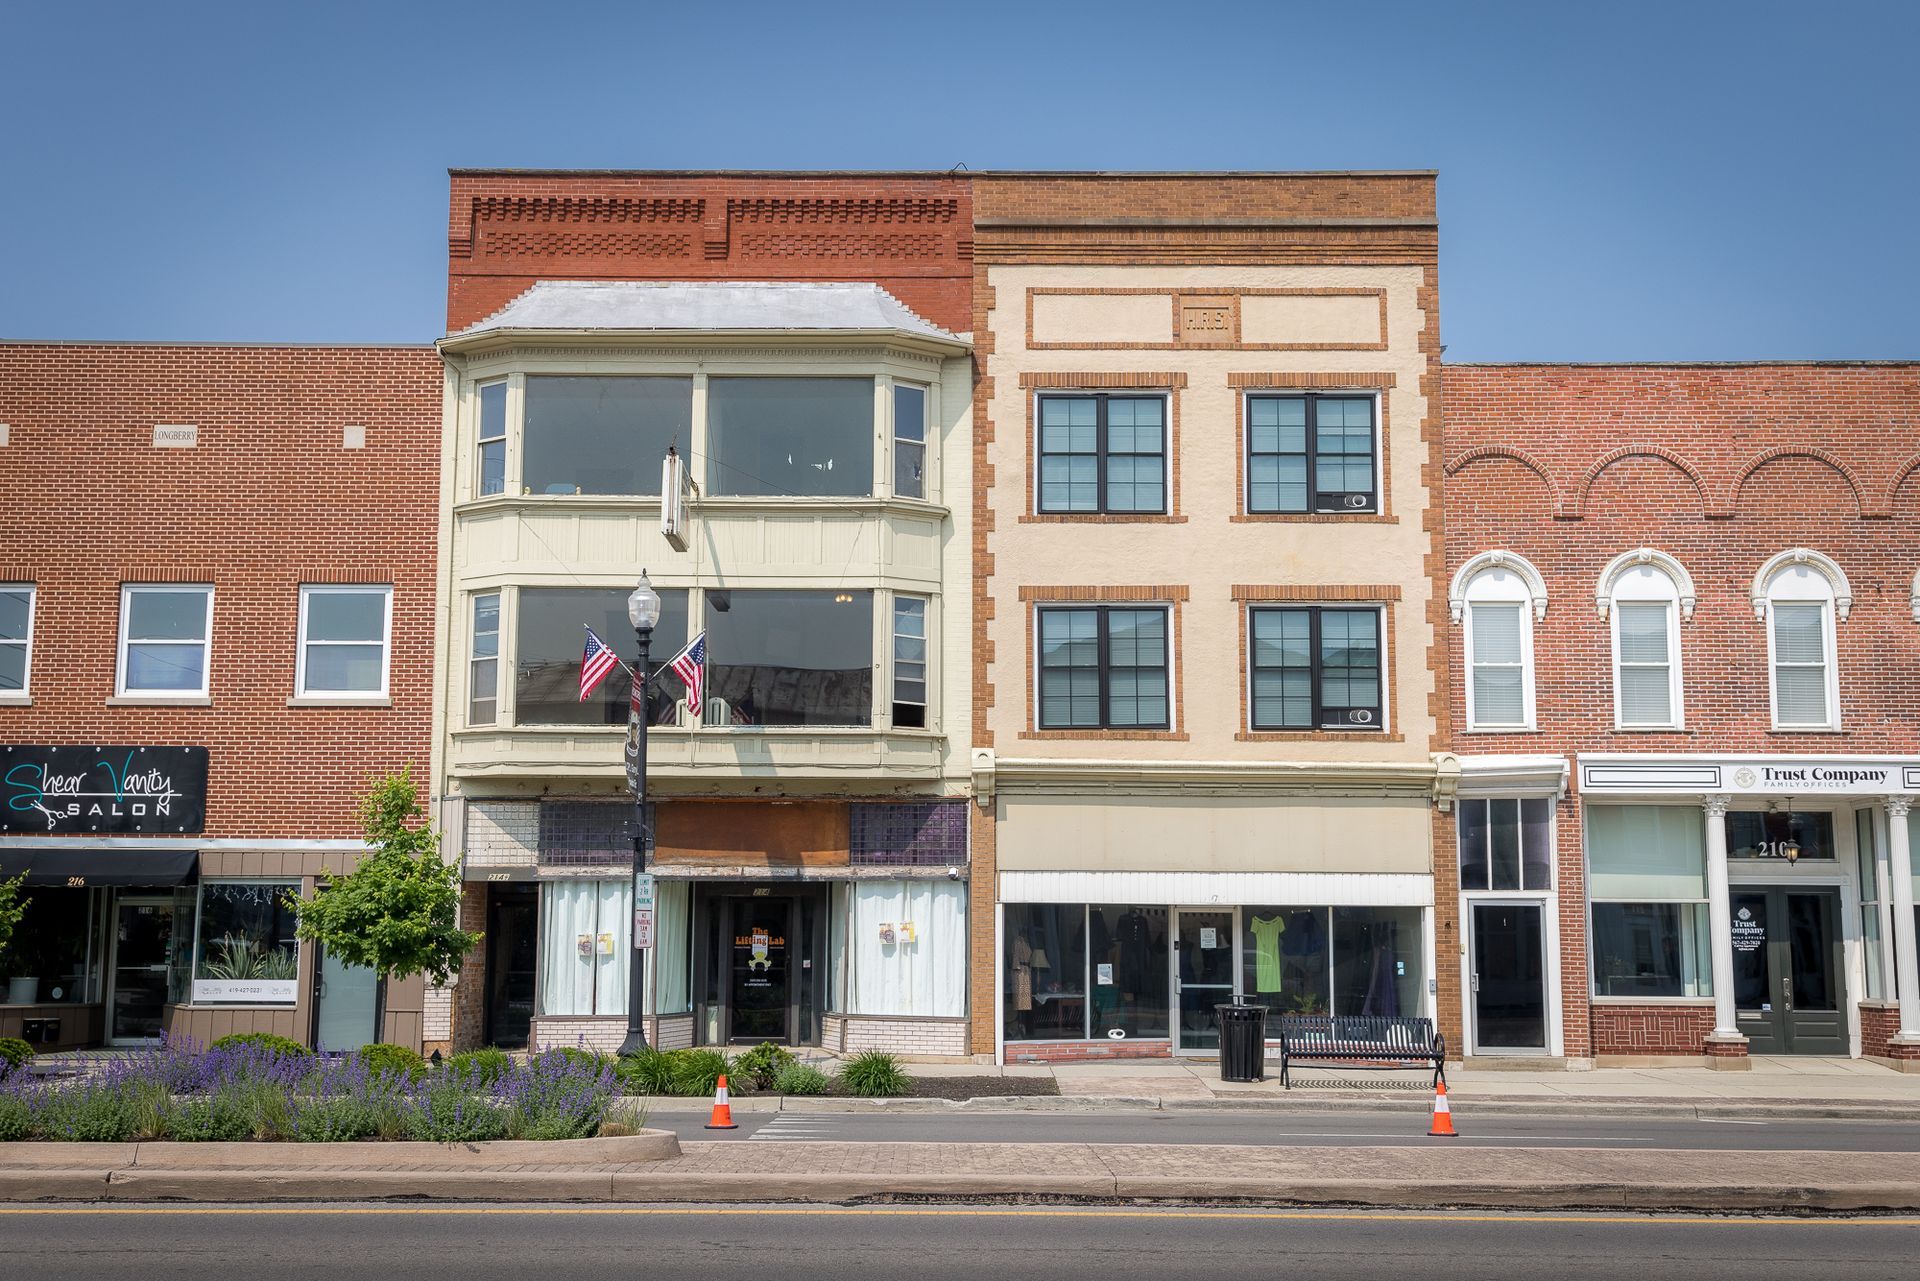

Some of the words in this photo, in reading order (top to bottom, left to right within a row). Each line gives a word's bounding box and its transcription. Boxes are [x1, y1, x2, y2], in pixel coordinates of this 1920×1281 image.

[154, 430, 197, 441] LONGBERRY
[5, 762, 87, 811] Shear
[96, 750, 175, 806] Vanity
[1761, 767, 1807, 781] Trust
[1811, 767, 1889, 785] Company
[67, 803, 170, 816] SALON
[67, 876, 85, 887] 216
[752, 927, 769, 935] The
[1731, 928, 1765, 936] ompany
[735, 935, 768, 947] Lifting
[768, 936, 785, 945] Lab
